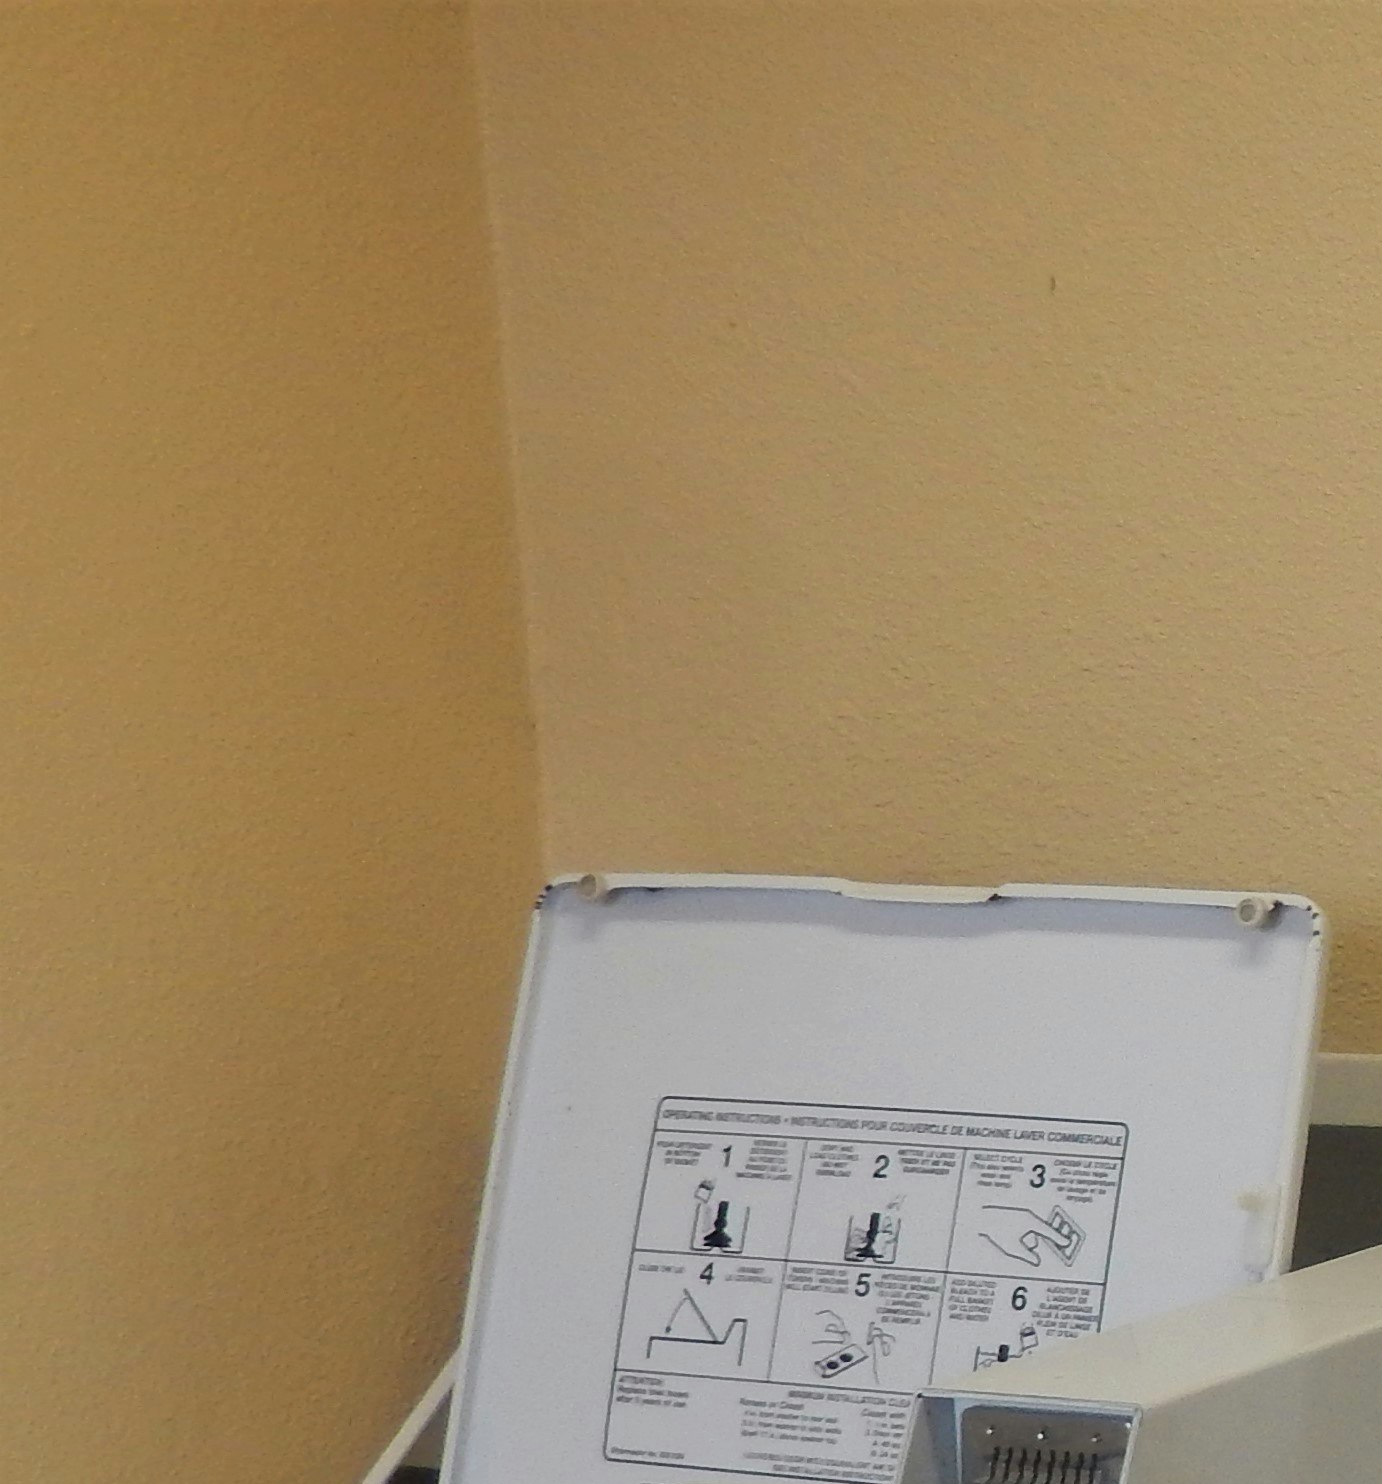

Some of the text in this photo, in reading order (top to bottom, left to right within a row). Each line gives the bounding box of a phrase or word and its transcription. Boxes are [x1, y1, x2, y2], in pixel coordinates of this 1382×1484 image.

[860, 1119, 887, 1131] POUR
[950, 1125, 964, 1135] DE
[965, 1126, 1011, 1138] MACHINE
[1013, 1129, 1045, 1141] LAVER
[1047, 1131, 1122, 1146] COMMERCIALE
[719, 1145, 733, 1167] 1
[872, 1154, 891, 1178] 2
[1028, 1164, 1047, 1189] 3
[697, 1262, 715, 1286] 4
[854, 1273, 872, 1297] 5
[1009, 1286, 1029, 1310] 6
